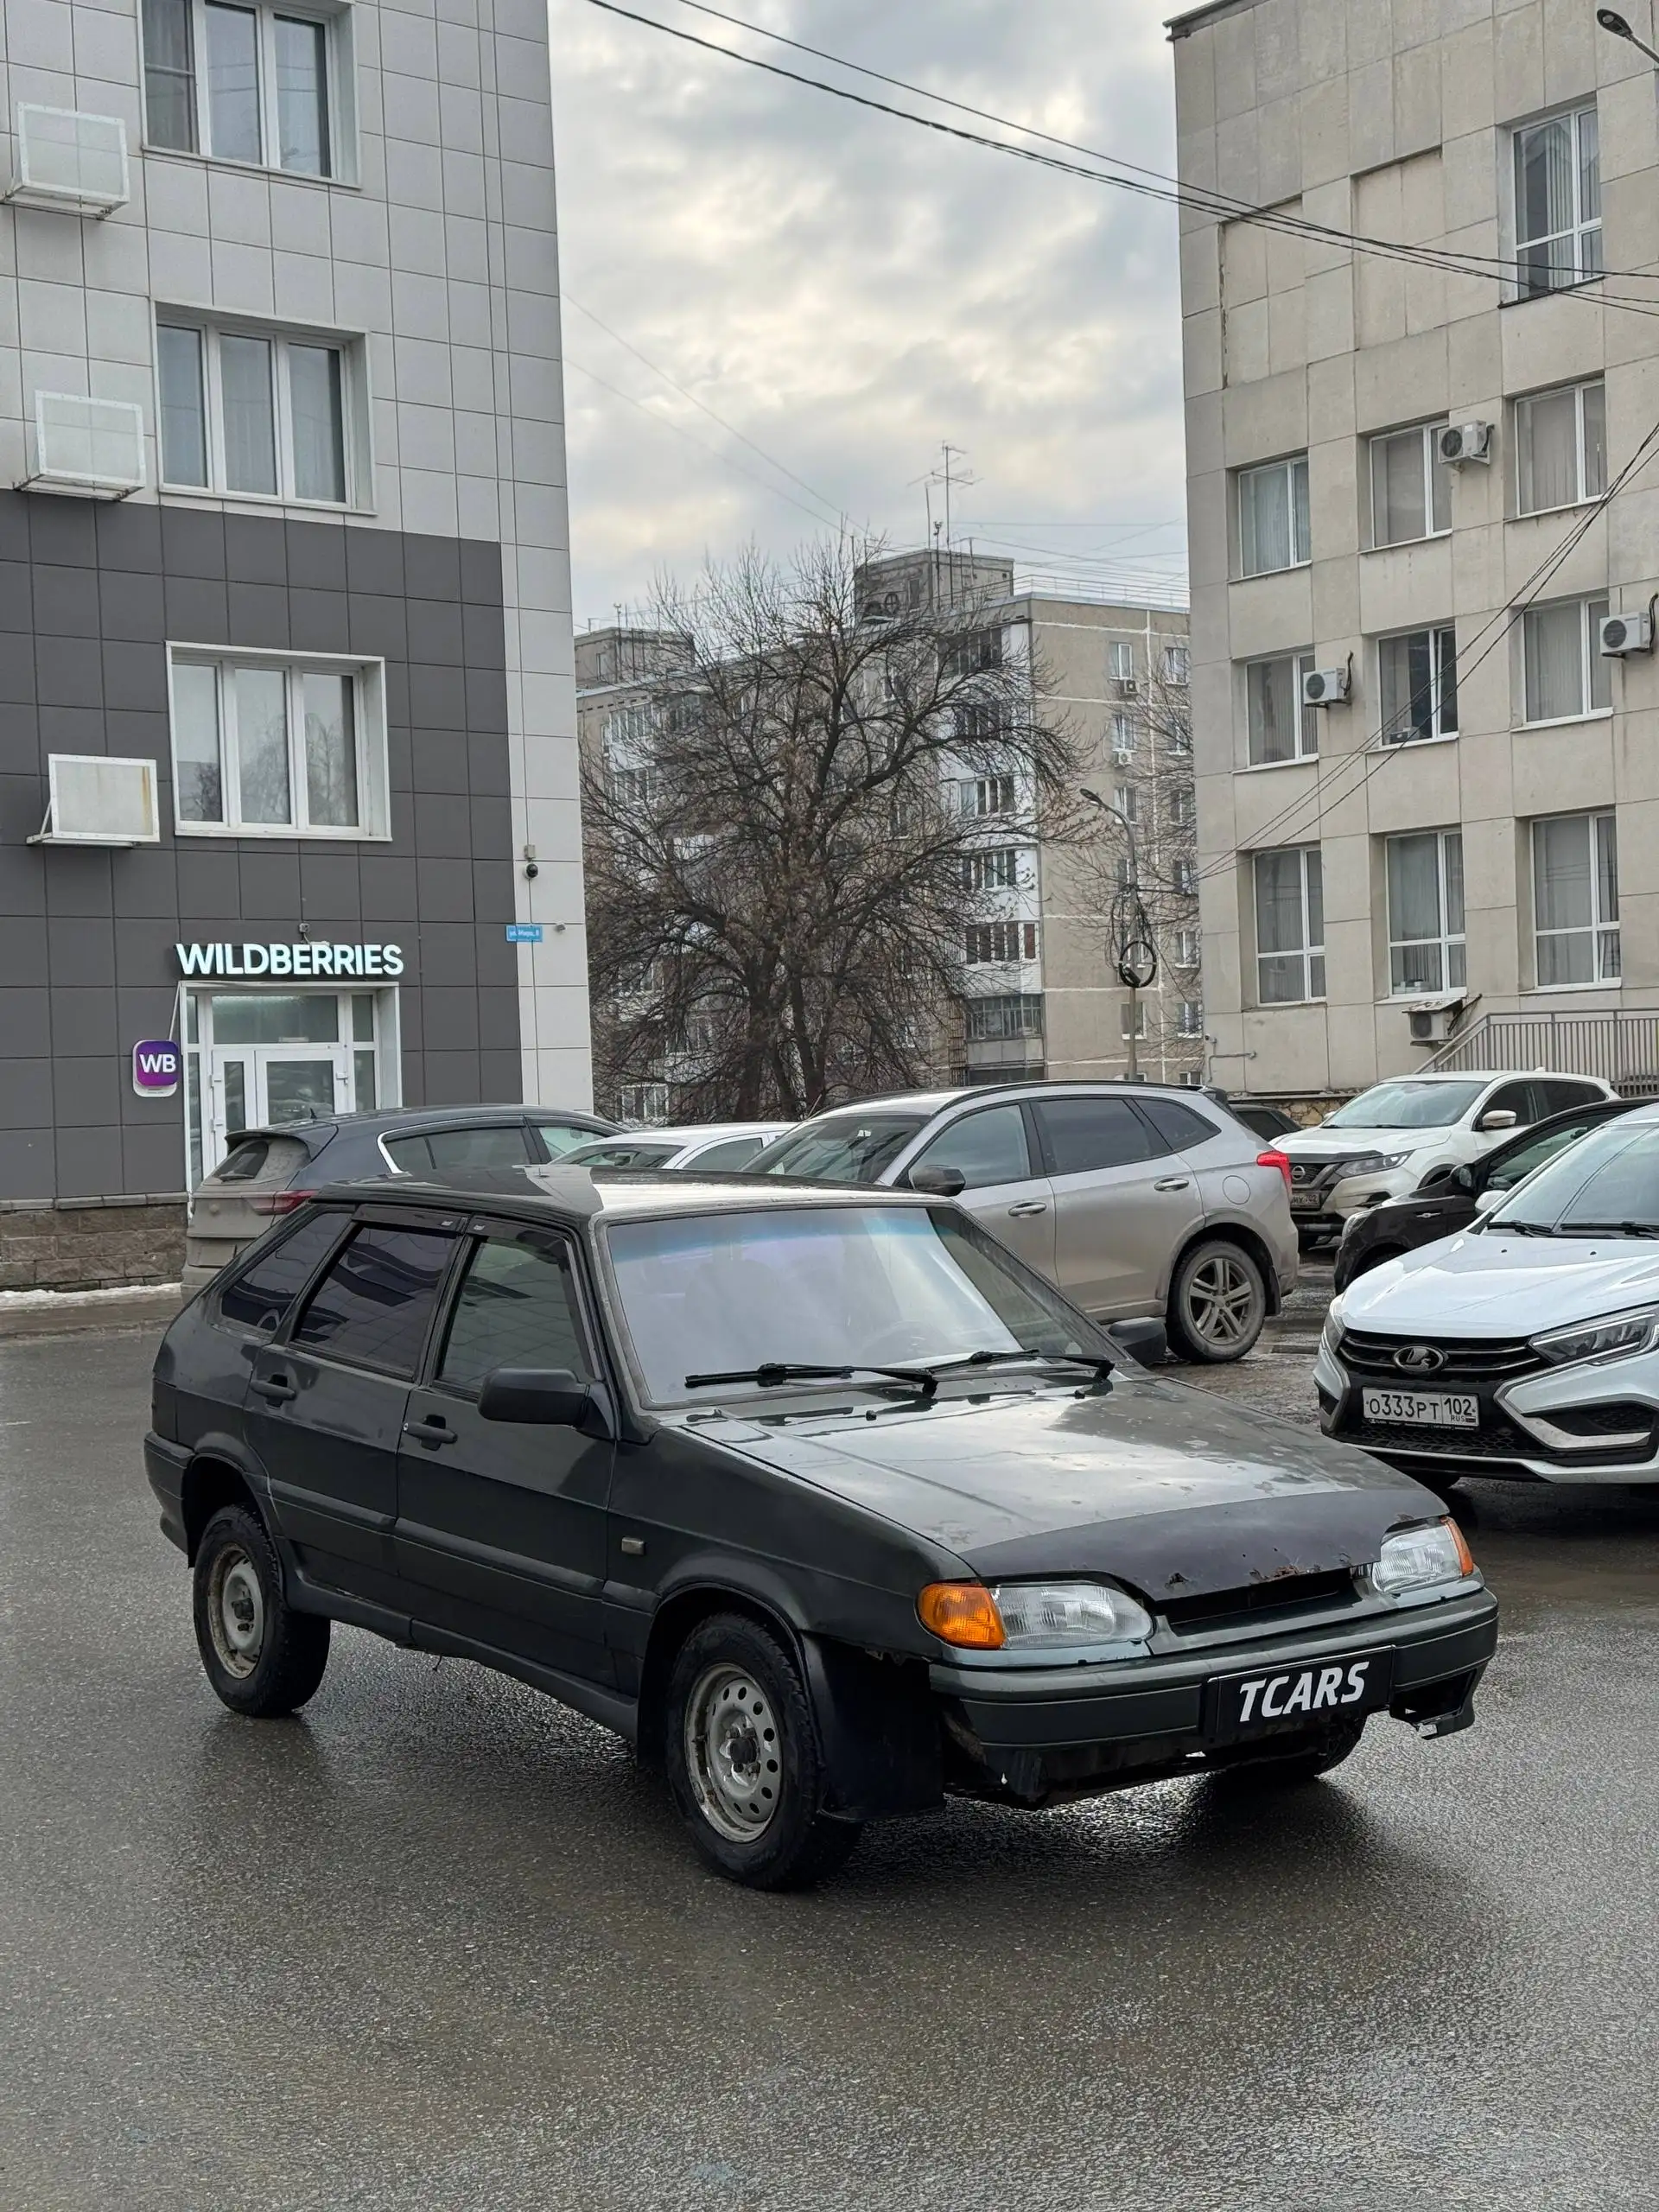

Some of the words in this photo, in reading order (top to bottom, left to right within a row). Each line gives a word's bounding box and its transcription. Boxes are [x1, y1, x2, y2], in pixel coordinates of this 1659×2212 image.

[175, 943, 404, 976] WILDBERRIES
[139, 1054, 177, 1073] WB
[1444, 1397, 1472, 1416] 102
[1239, 1661, 1370, 1723] TCARS
